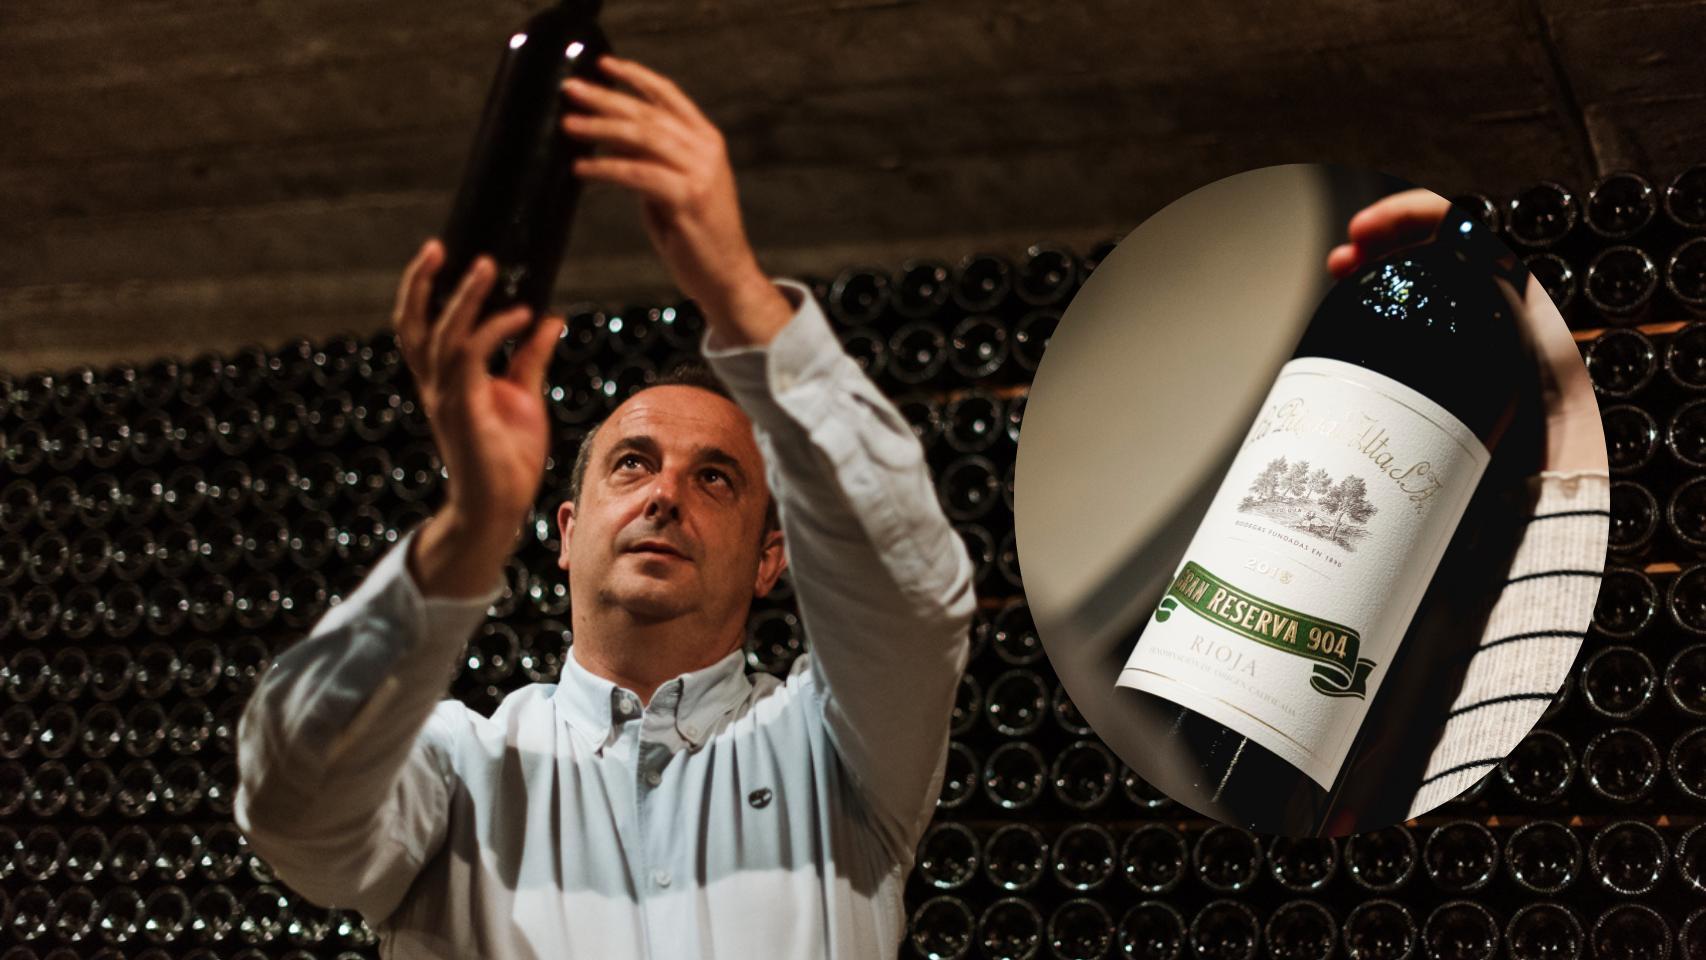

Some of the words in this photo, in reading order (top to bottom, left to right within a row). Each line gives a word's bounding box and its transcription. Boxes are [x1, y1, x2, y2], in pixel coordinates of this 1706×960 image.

[1267, 530, 1309, 550] FUNDADAS
[1311, 548, 1322, 557] EN
[1206, 588, 1299, 645] RESERVA
[1307, 626, 1349, 659] 904
[1190, 634, 1257, 676] RIOJA
